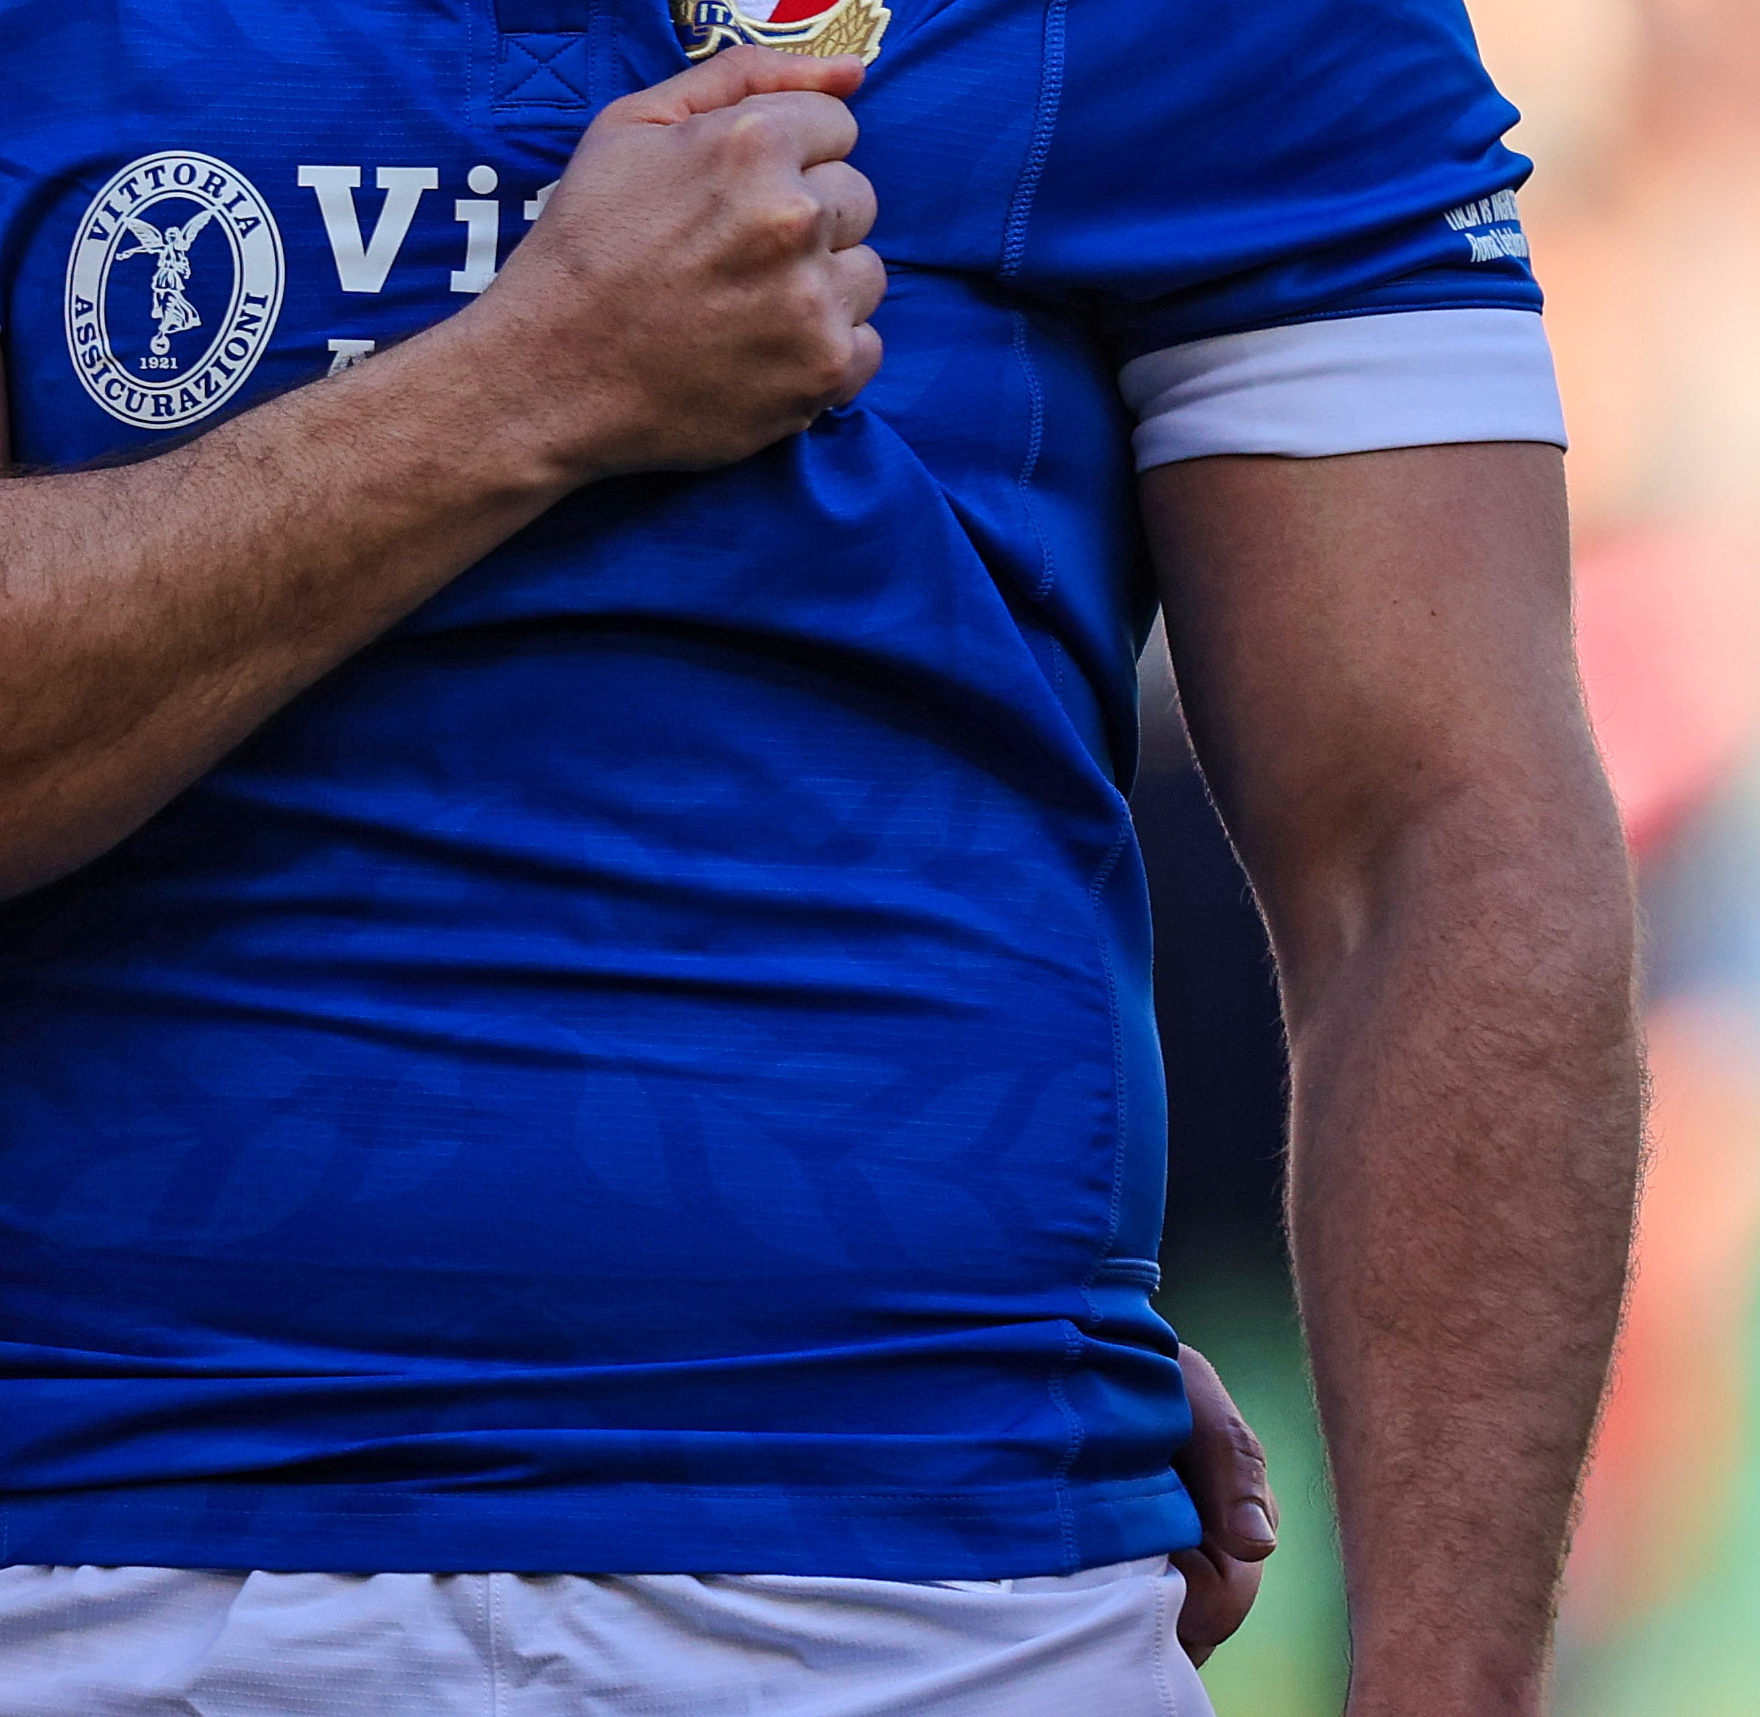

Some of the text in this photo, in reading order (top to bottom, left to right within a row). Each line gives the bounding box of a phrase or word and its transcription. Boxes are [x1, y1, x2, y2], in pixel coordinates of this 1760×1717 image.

[87, 162, 263, 245] VITTORIA
[74, 292, 270, 418] ASSICURAZIONI
[139, 357, 179, 370] 1921
